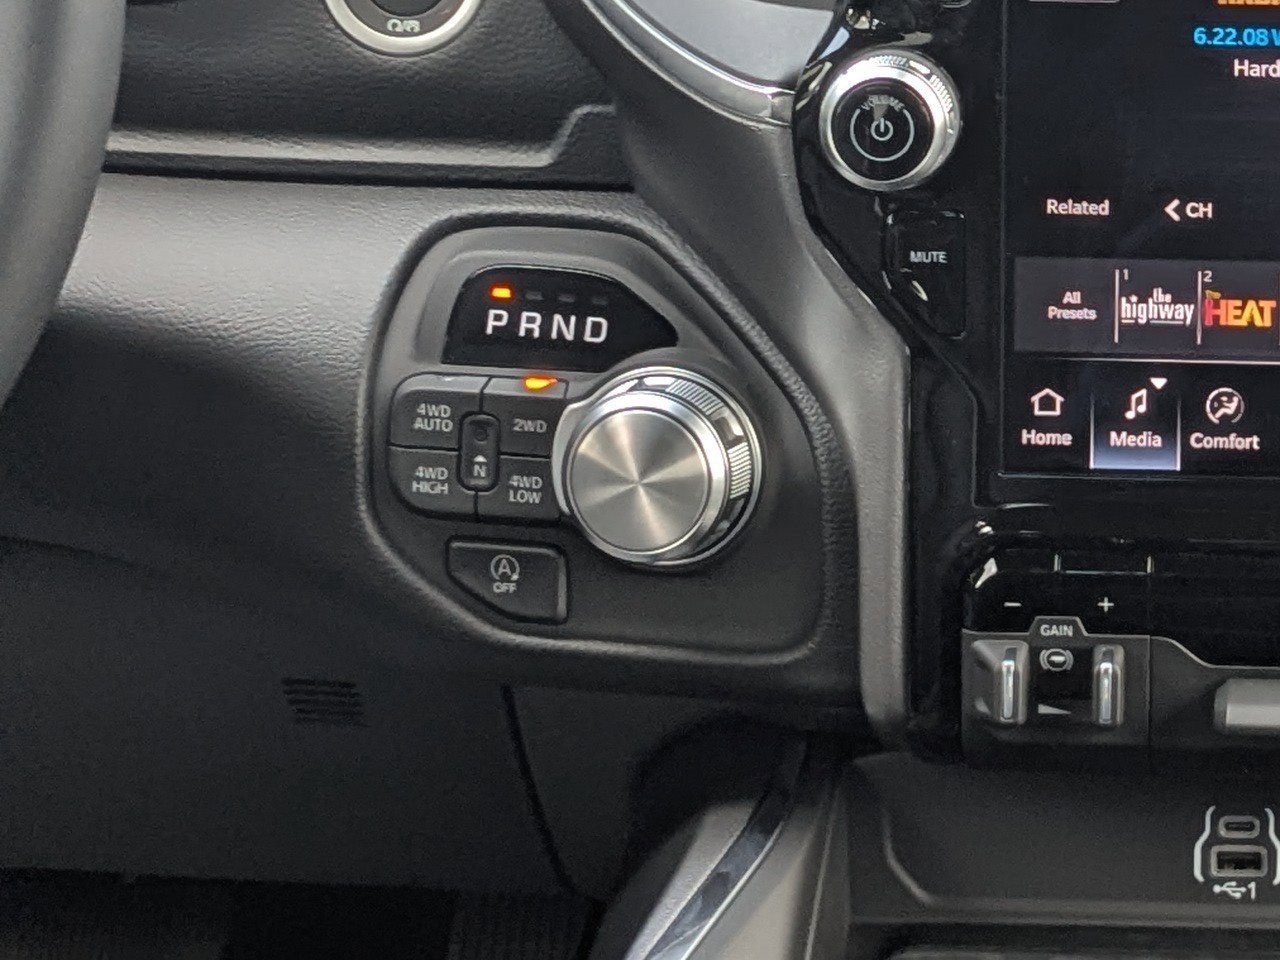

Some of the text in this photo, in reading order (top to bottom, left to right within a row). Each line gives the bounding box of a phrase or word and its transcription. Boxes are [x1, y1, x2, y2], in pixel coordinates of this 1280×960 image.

[1193, 27, 1269, 46] 6.22.08
[1234, 59, 1280, 78] Hard
[1046, 198, 1110, 216] Related
[1185, 202, 1213, 218] CH
[910, 250, 947, 263] MUTE
[1123, 268, 1129, 280] 1
[1203, 270, 1213, 282] 2
[1062, 291, 1081, 304] All
[1153, 287, 1172, 303] the
[1048, 305, 1097, 320] Presets
[1120, 295, 1195, 326] highway
[1204, 299, 1276, 327] HEAT
[417, 403, 451, 417] 4WD
[413, 418, 453, 432] AUTO
[513, 418, 547, 433] 2WD
[1021, 429, 1072, 447] Home
[1110, 431, 1162, 448] Media
[1190, 432, 1260, 450] Comfort
[415, 466, 449, 480] 4WD
[473, 465, 486, 477] N
[412, 481, 449, 494] HIGH
[509, 475, 542, 489] 4WD
[509, 490, 542, 504] LOW
[493, 582, 517, 593] OFF
[1040, 625, 1073, 637] GAIN
[1248, 881, 1257, 900] 1
